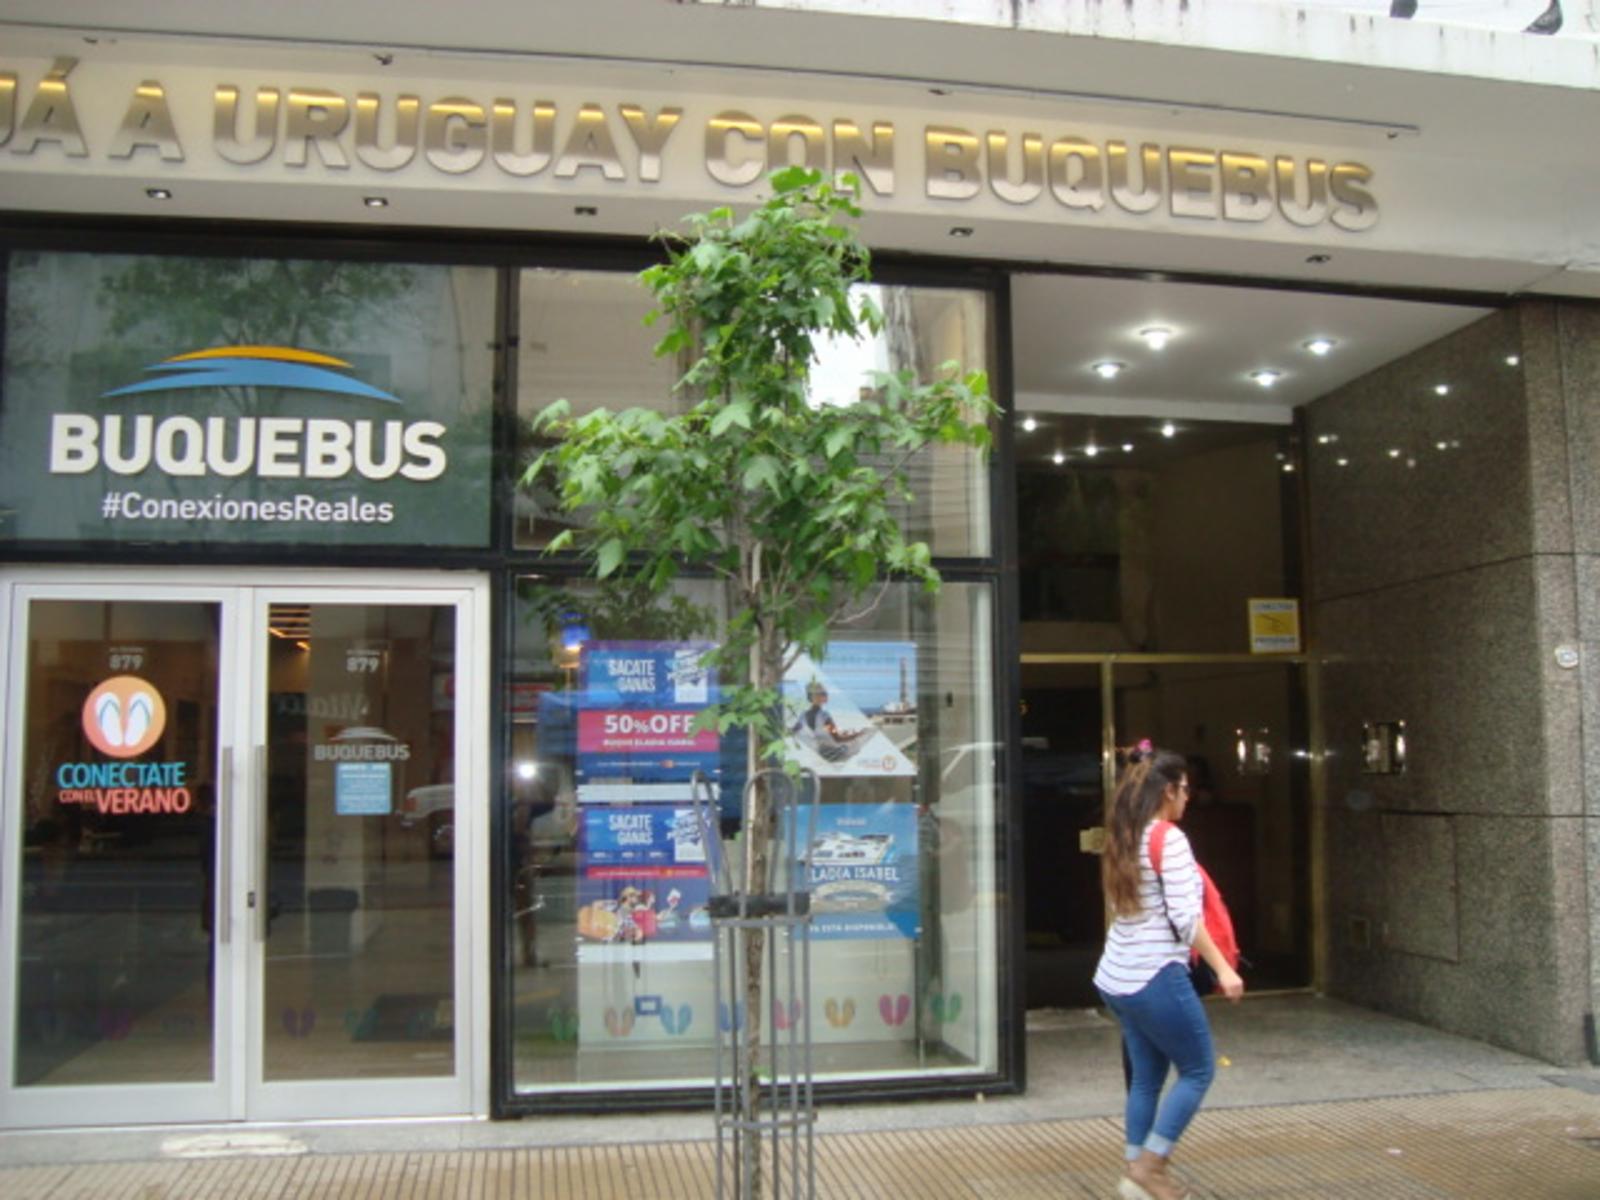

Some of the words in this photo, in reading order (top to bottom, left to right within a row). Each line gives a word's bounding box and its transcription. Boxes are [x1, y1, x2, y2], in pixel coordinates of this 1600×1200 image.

[106, 79, 186, 163] A
[212, 84, 683, 182] URUGUAY
[704, 110, 895, 197] CON
[925, 124, 1380, 232] BUQUEBUS
[50, 414, 447, 481] BUQUEBUS
[102, 491, 394, 525] #ConexionesReales
[109, 654, 144, 670] 879
[346, 657, 380, 672] 879
[314, 744, 411, 761] BUQUEBUS
[57, 762, 187, 788] CONECTATE
[95, 787, 192, 814] VERANO
